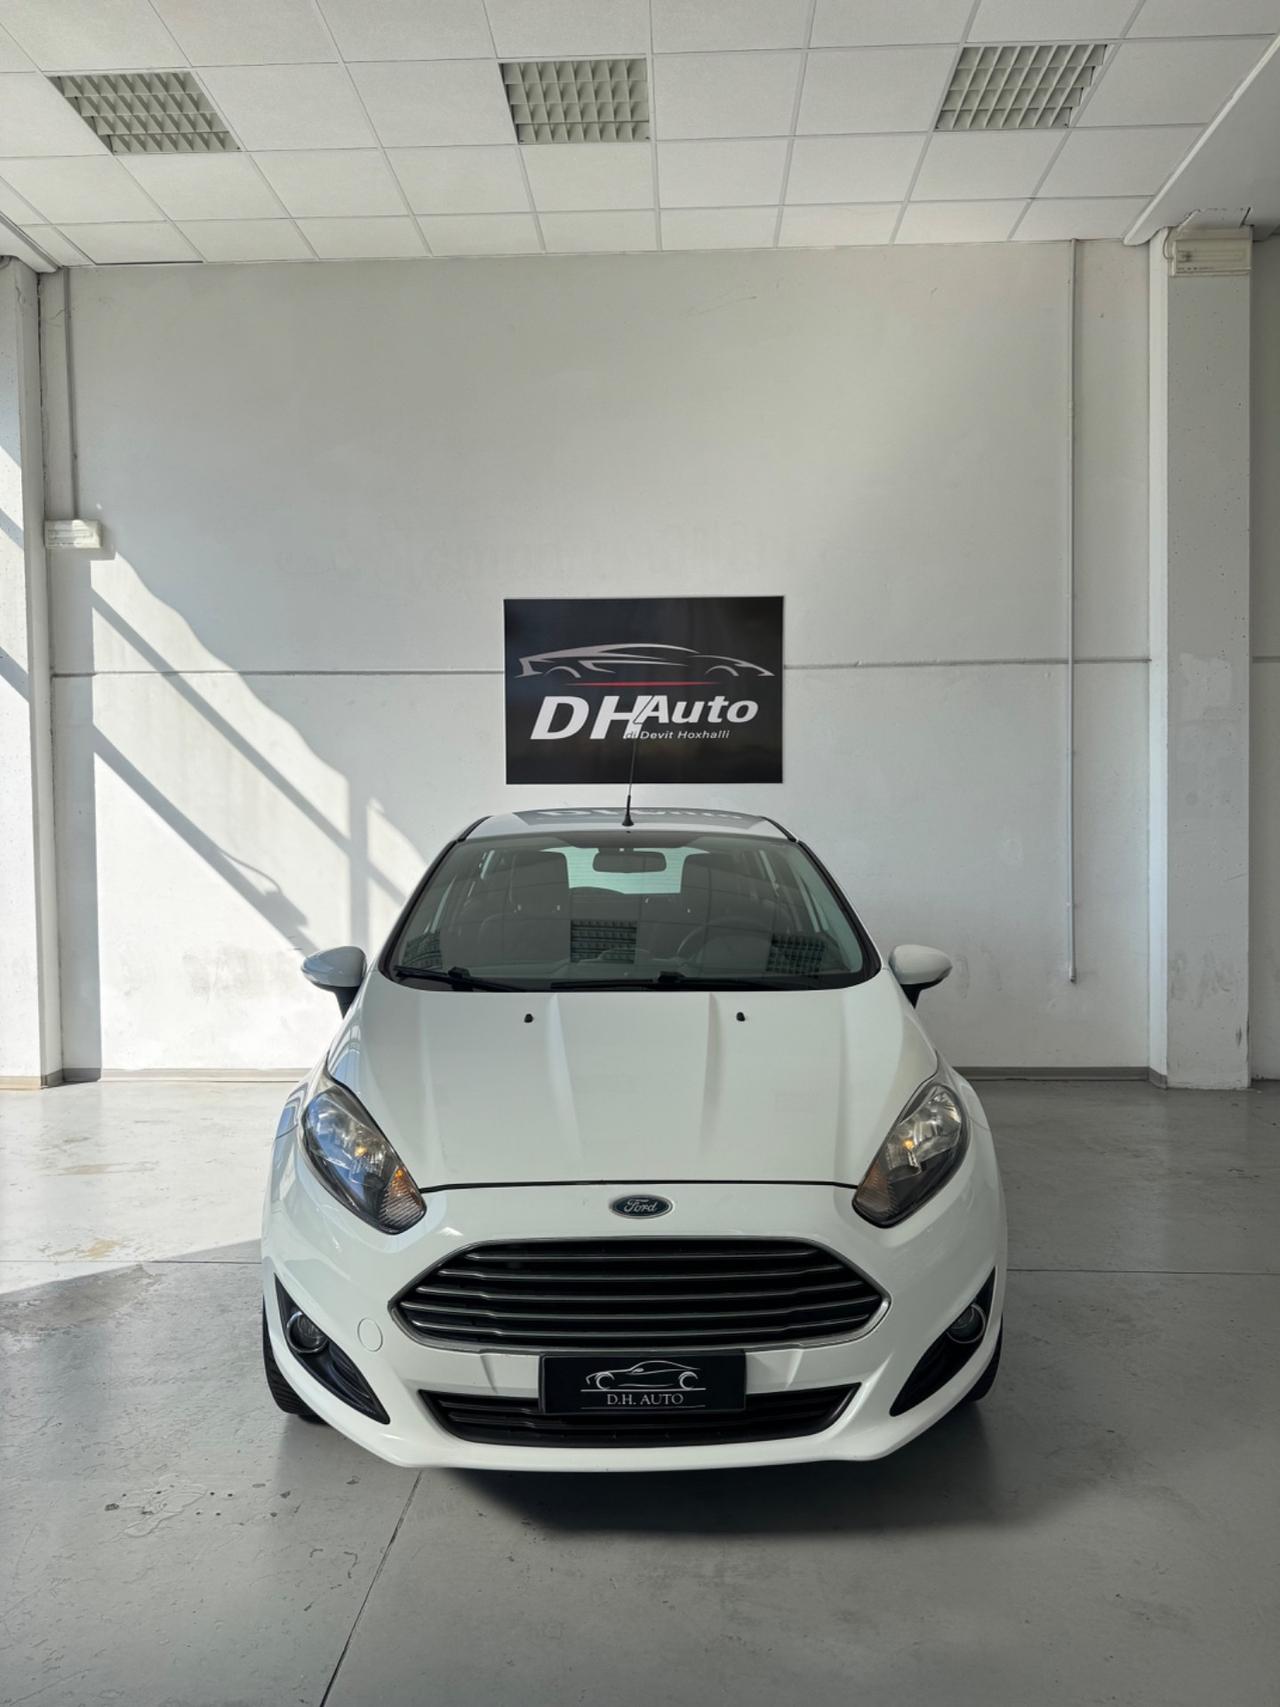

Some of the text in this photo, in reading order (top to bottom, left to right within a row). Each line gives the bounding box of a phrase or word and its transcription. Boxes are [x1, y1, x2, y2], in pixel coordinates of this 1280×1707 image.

[640, 730, 674, 740] Devit
[677, 730, 730, 740] Hoxhalli
[623, 1199, 658, 1212] Ford
[607, 1393, 684, 1405] D.H. AUTO
